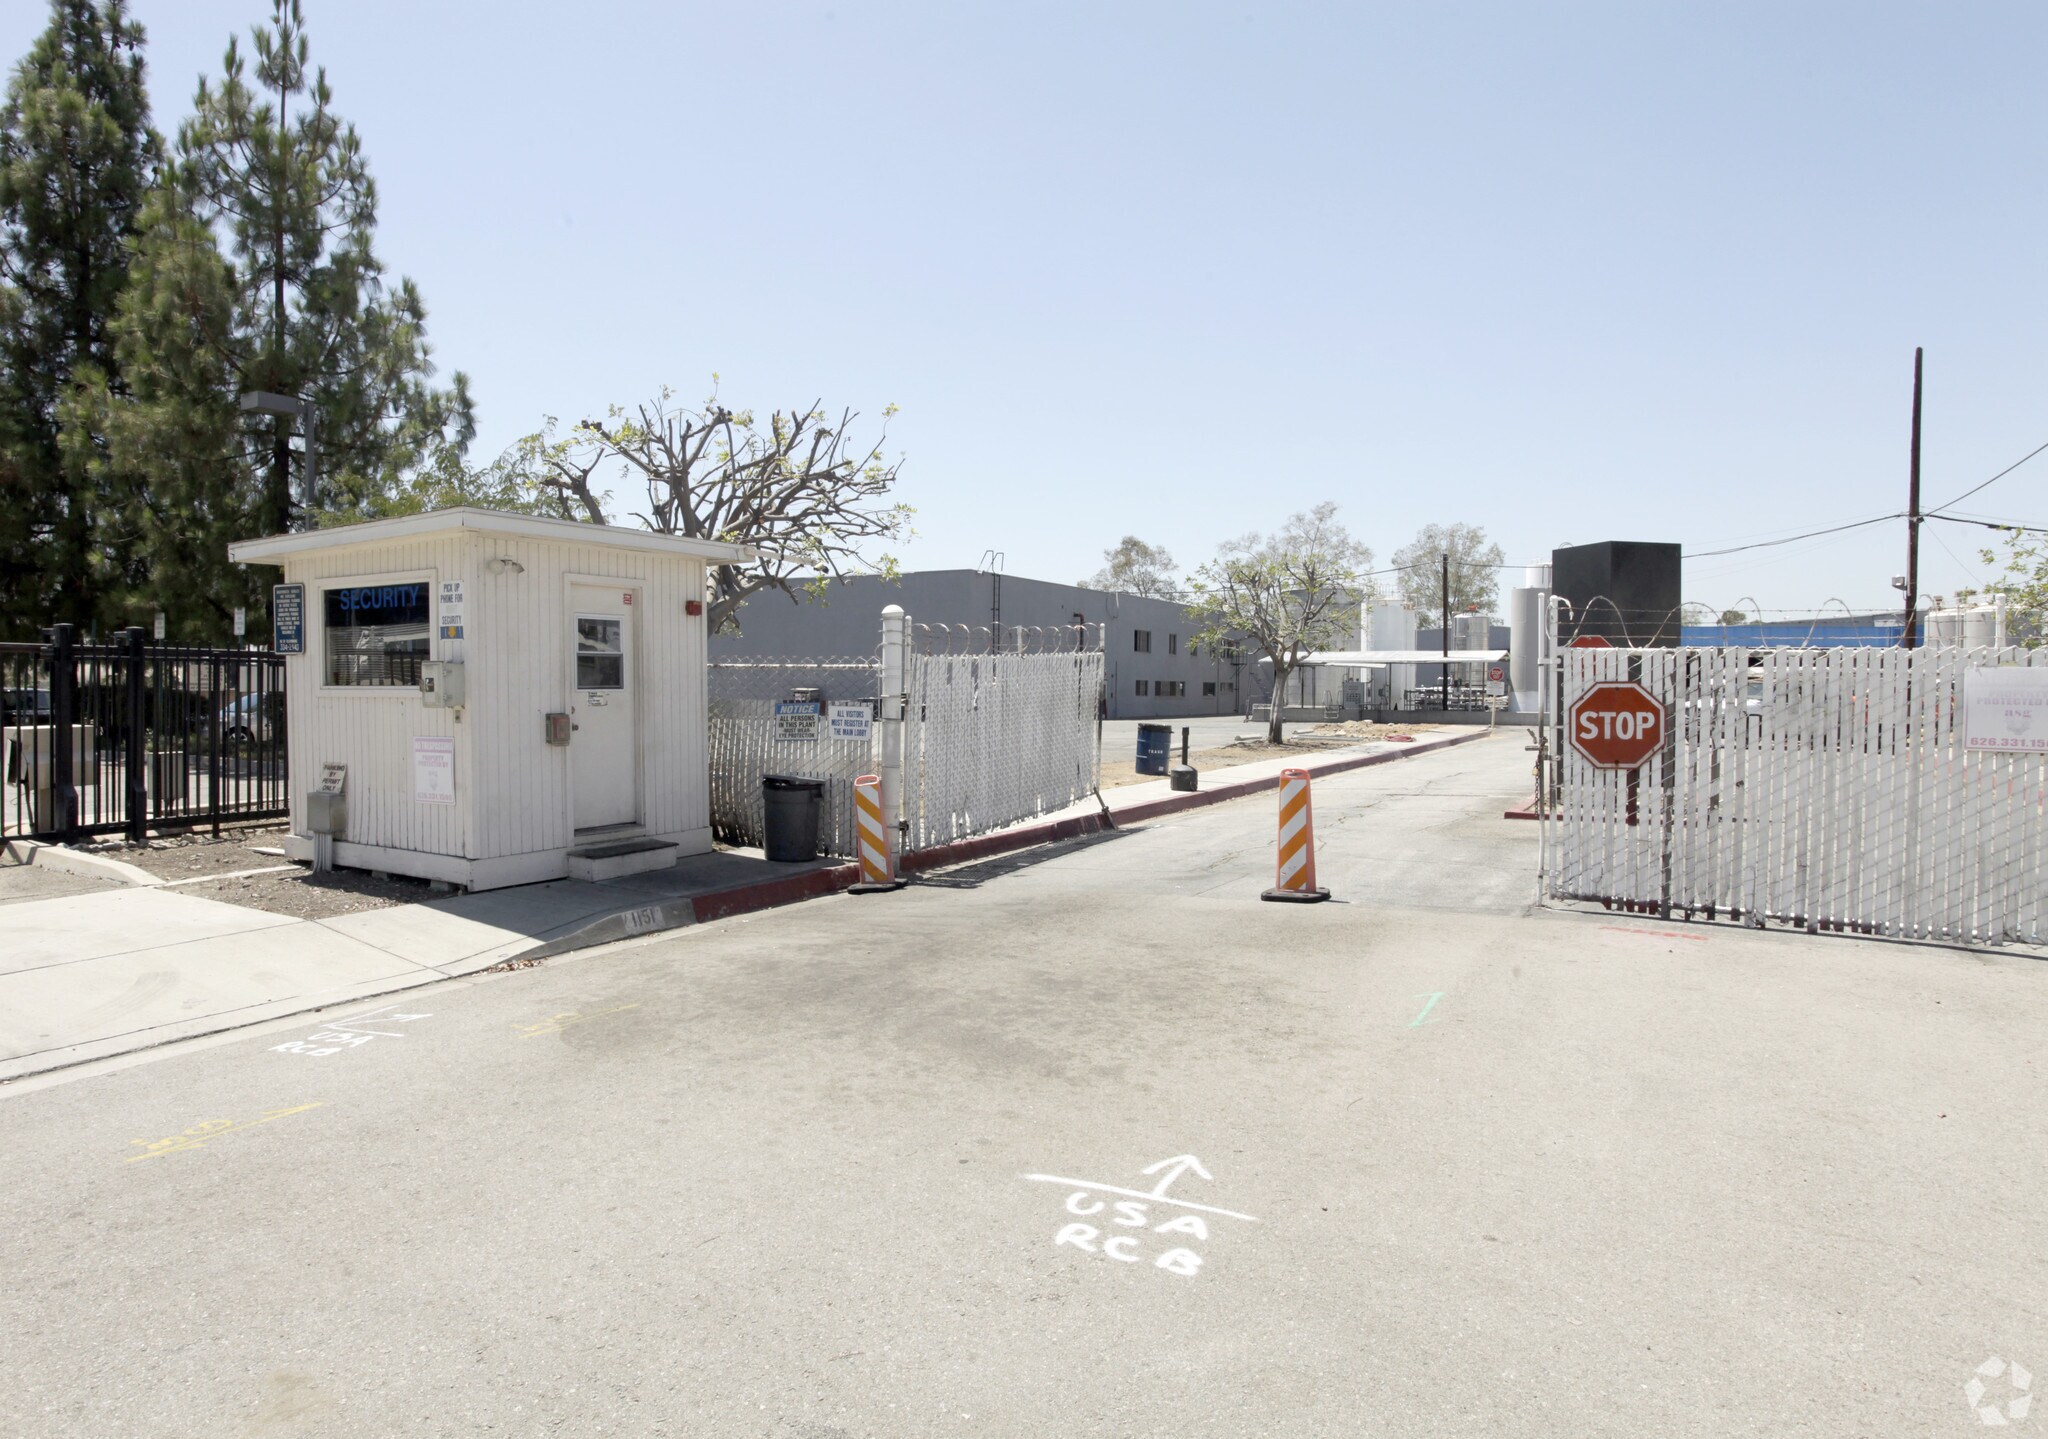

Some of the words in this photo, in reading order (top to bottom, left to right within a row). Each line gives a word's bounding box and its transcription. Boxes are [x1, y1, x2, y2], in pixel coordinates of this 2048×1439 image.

[443, 584, 453, 593] PICK
[454, 583, 460, 591] UP
[340, 586, 420, 610] SECURITY
[440, 594, 453, 604] PHONE
[454, 594, 463, 602] FOR
[442, 615, 462, 625] SECURITY
[780, 704, 815, 714] NOTICE
[1580, 711, 1655, 740] STOP
[1970, 738, 2048, 748] 626.331.15
[1066, 1192, 1208, 1240] USA
